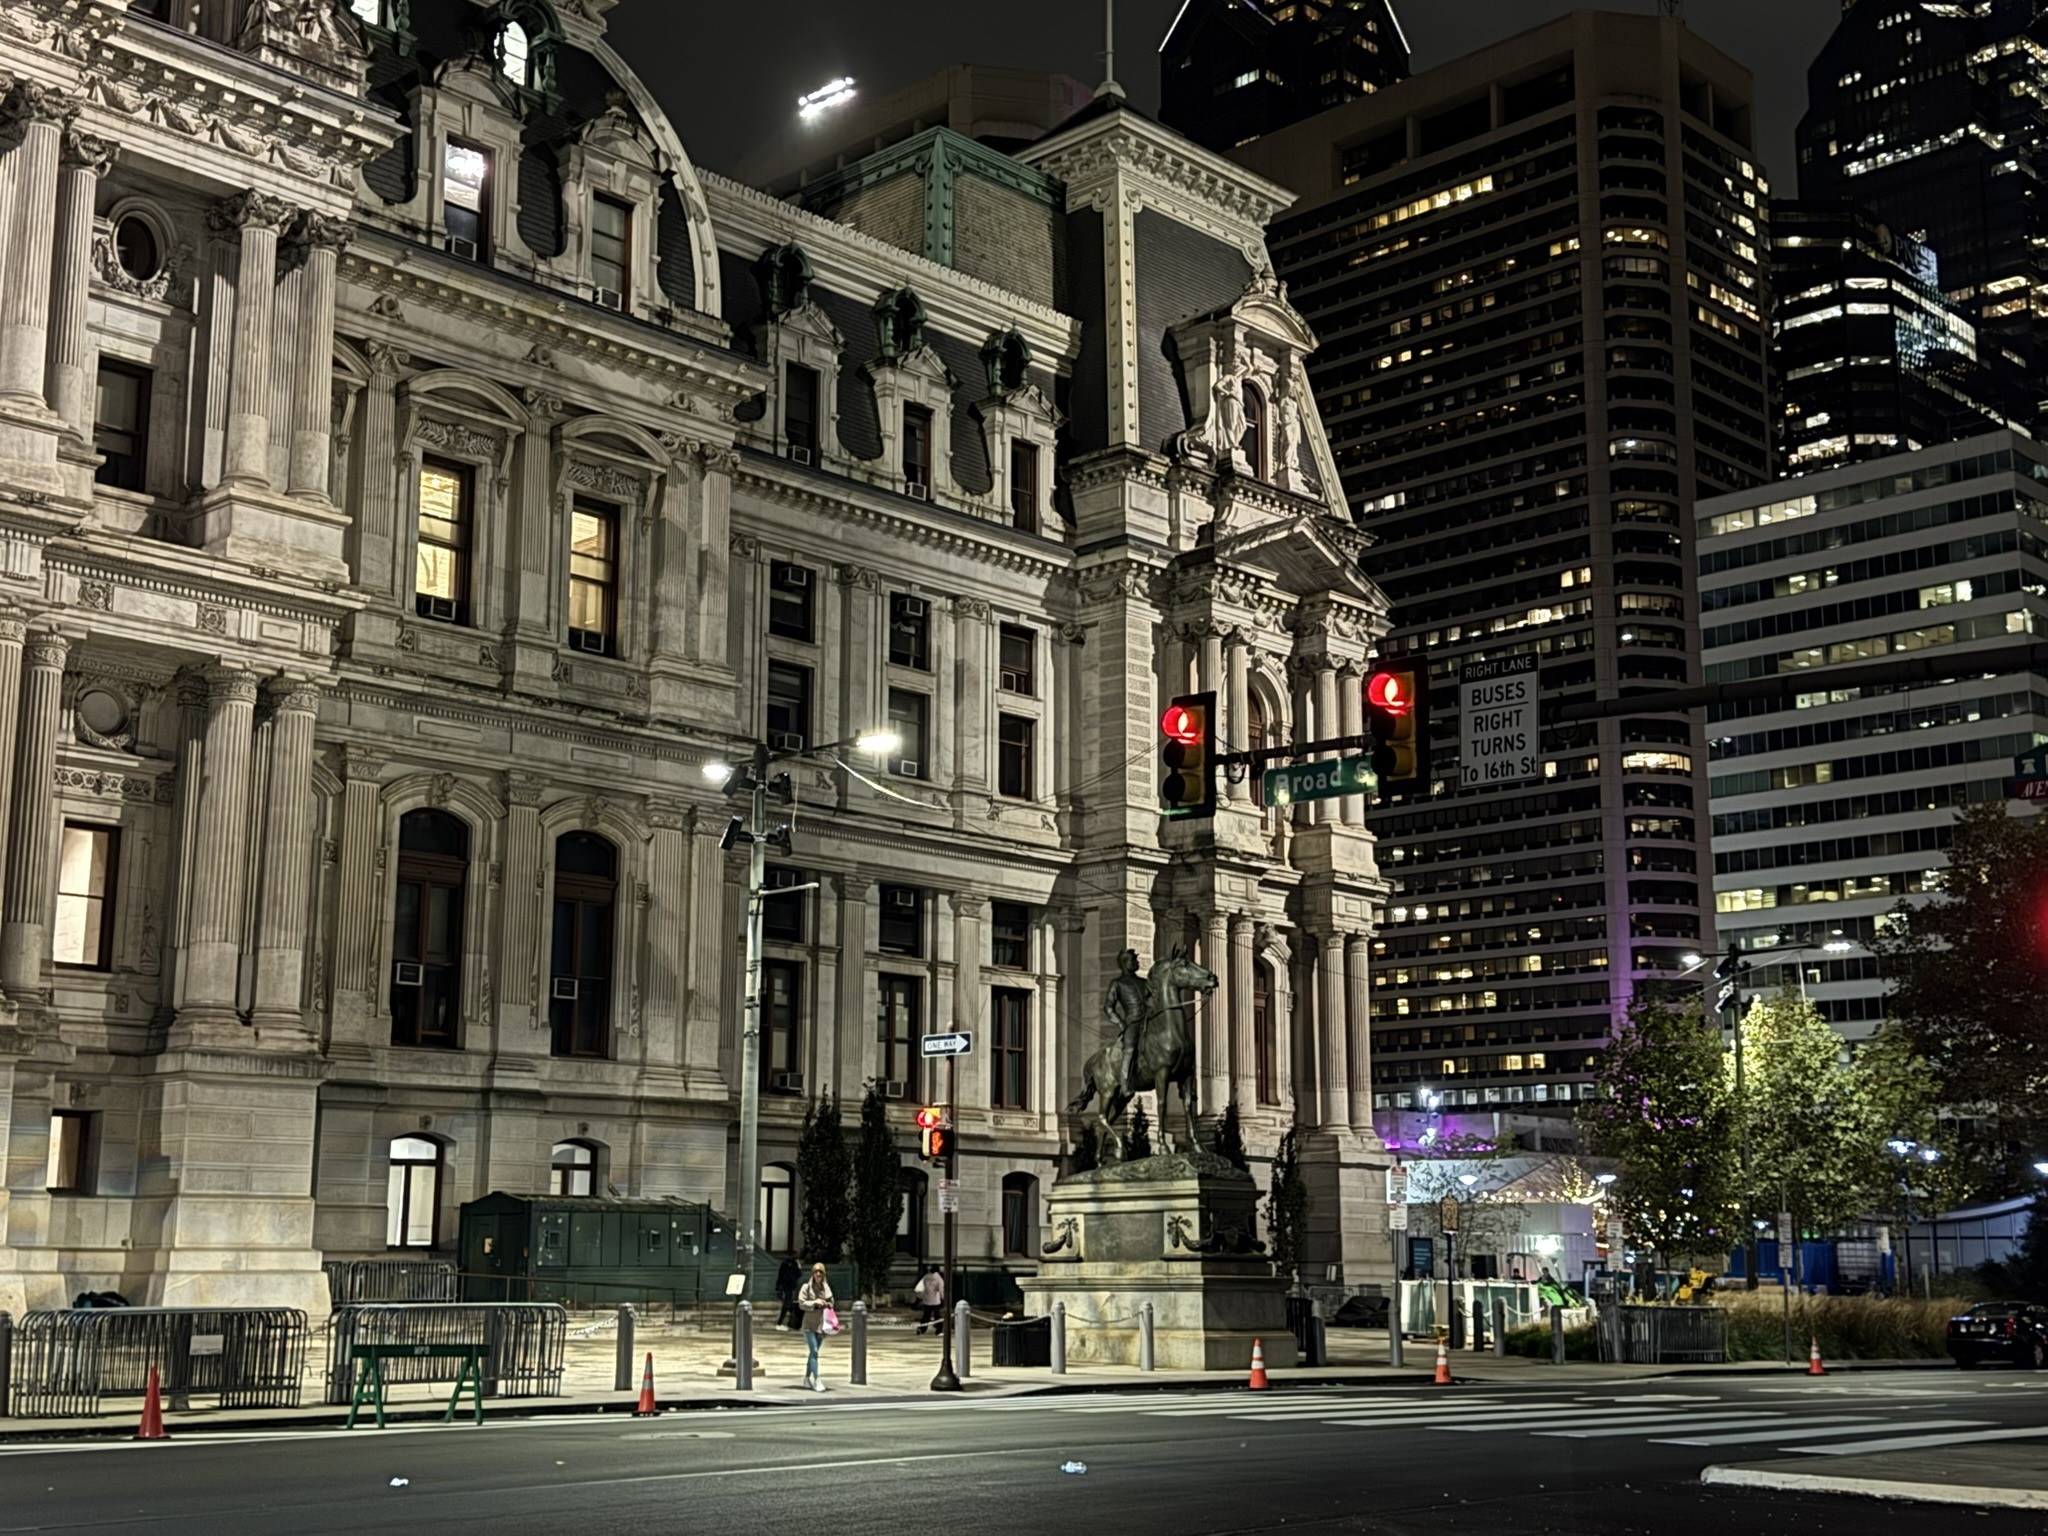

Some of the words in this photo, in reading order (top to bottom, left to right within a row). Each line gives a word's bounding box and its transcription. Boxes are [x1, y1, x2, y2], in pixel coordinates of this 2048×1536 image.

[1465, 662, 1499, 679] RIGHT
[1502, 656, 1532, 673] LANE
[1471, 681, 1526, 706] BUSES
[1473, 709, 1523, 733] RIGHT
[1471, 733, 1526, 757] TURNS
[1275, 761, 1342, 797] Broad
[1461, 765, 1479, 783] To
[1484, 759, 1515, 779] 16th
[1520, 756, 1536, 775] St
[927, 1041, 941, 1050] ONE
[943, 1040, 957, 1048] WAY
